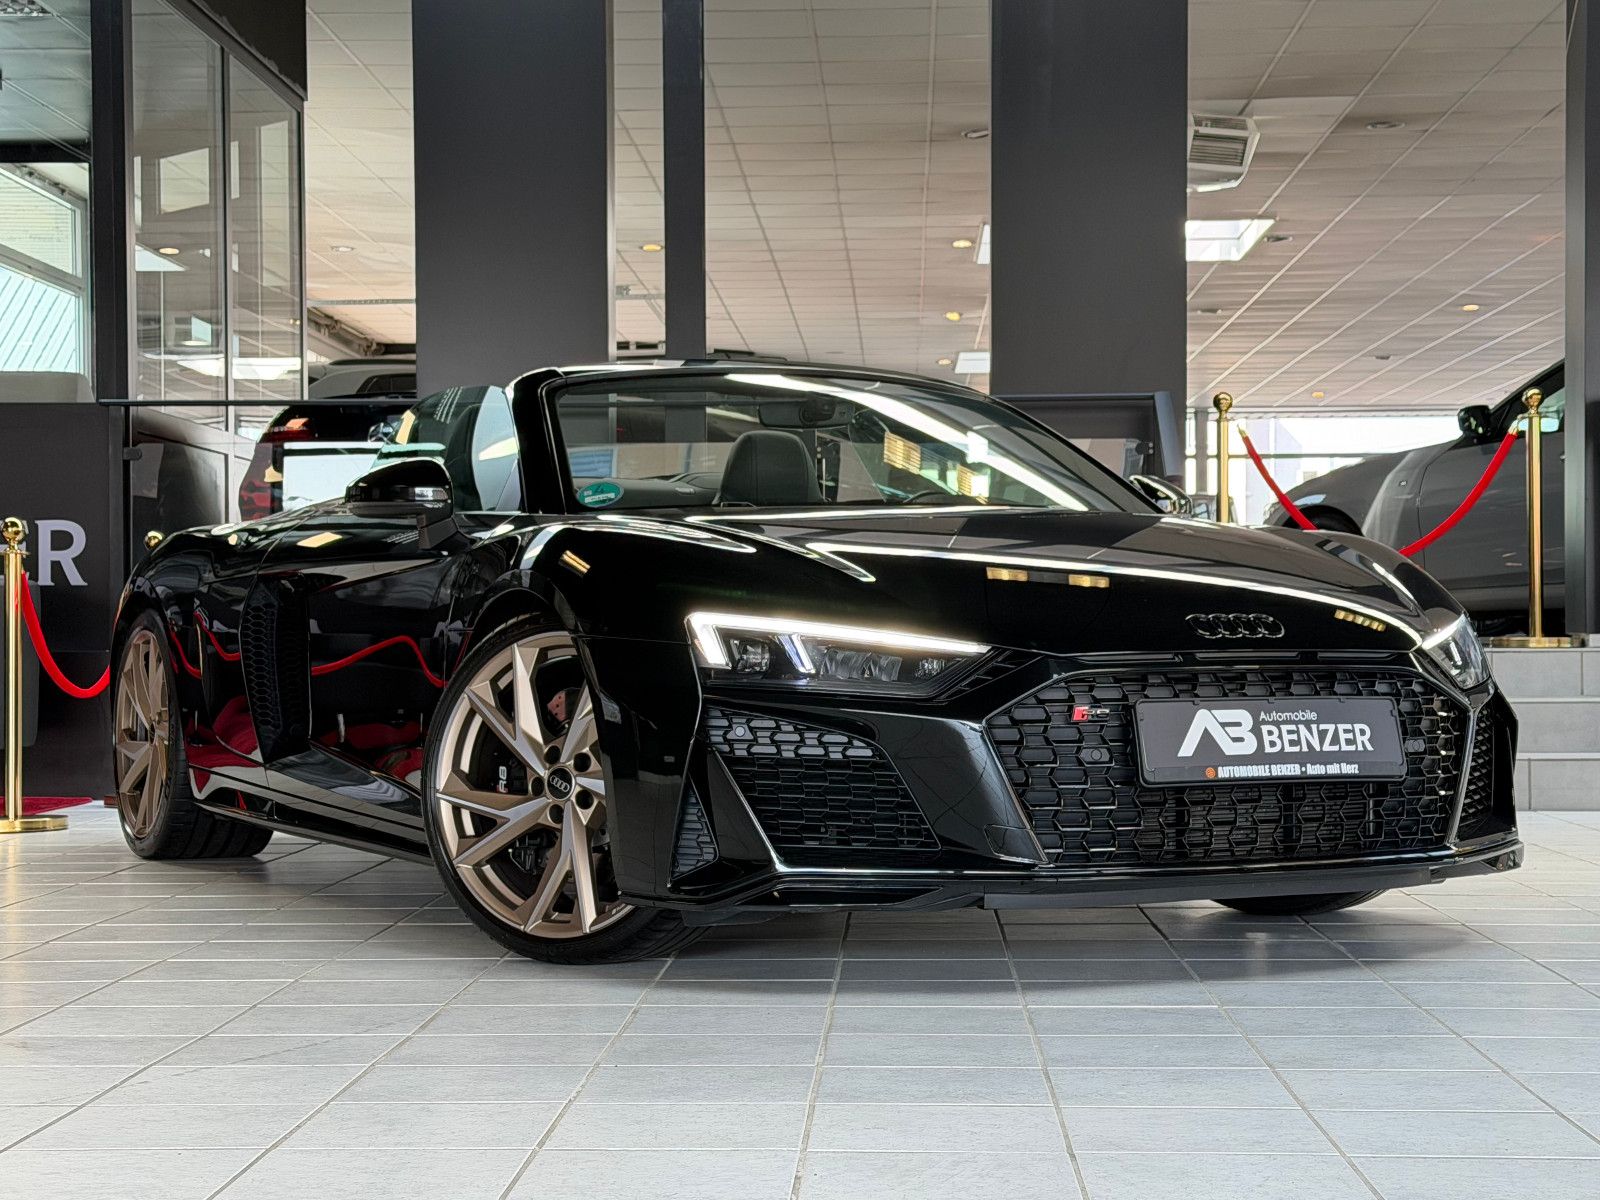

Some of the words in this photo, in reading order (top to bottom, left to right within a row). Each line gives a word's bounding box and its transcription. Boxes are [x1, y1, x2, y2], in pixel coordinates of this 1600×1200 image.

[1259, 709, 1318, 722] Automobile
[1260, 723, 1375, 754] BENZER
[1218, 764, 1270, 778] AUTOMOBILE
[1271, 763, 1301, 777] BENZER
[1306, 763, 1325, 776] Auto
[1326, 762, 1341, 775] mit
[1341, 762, 1359, 775] Herz
